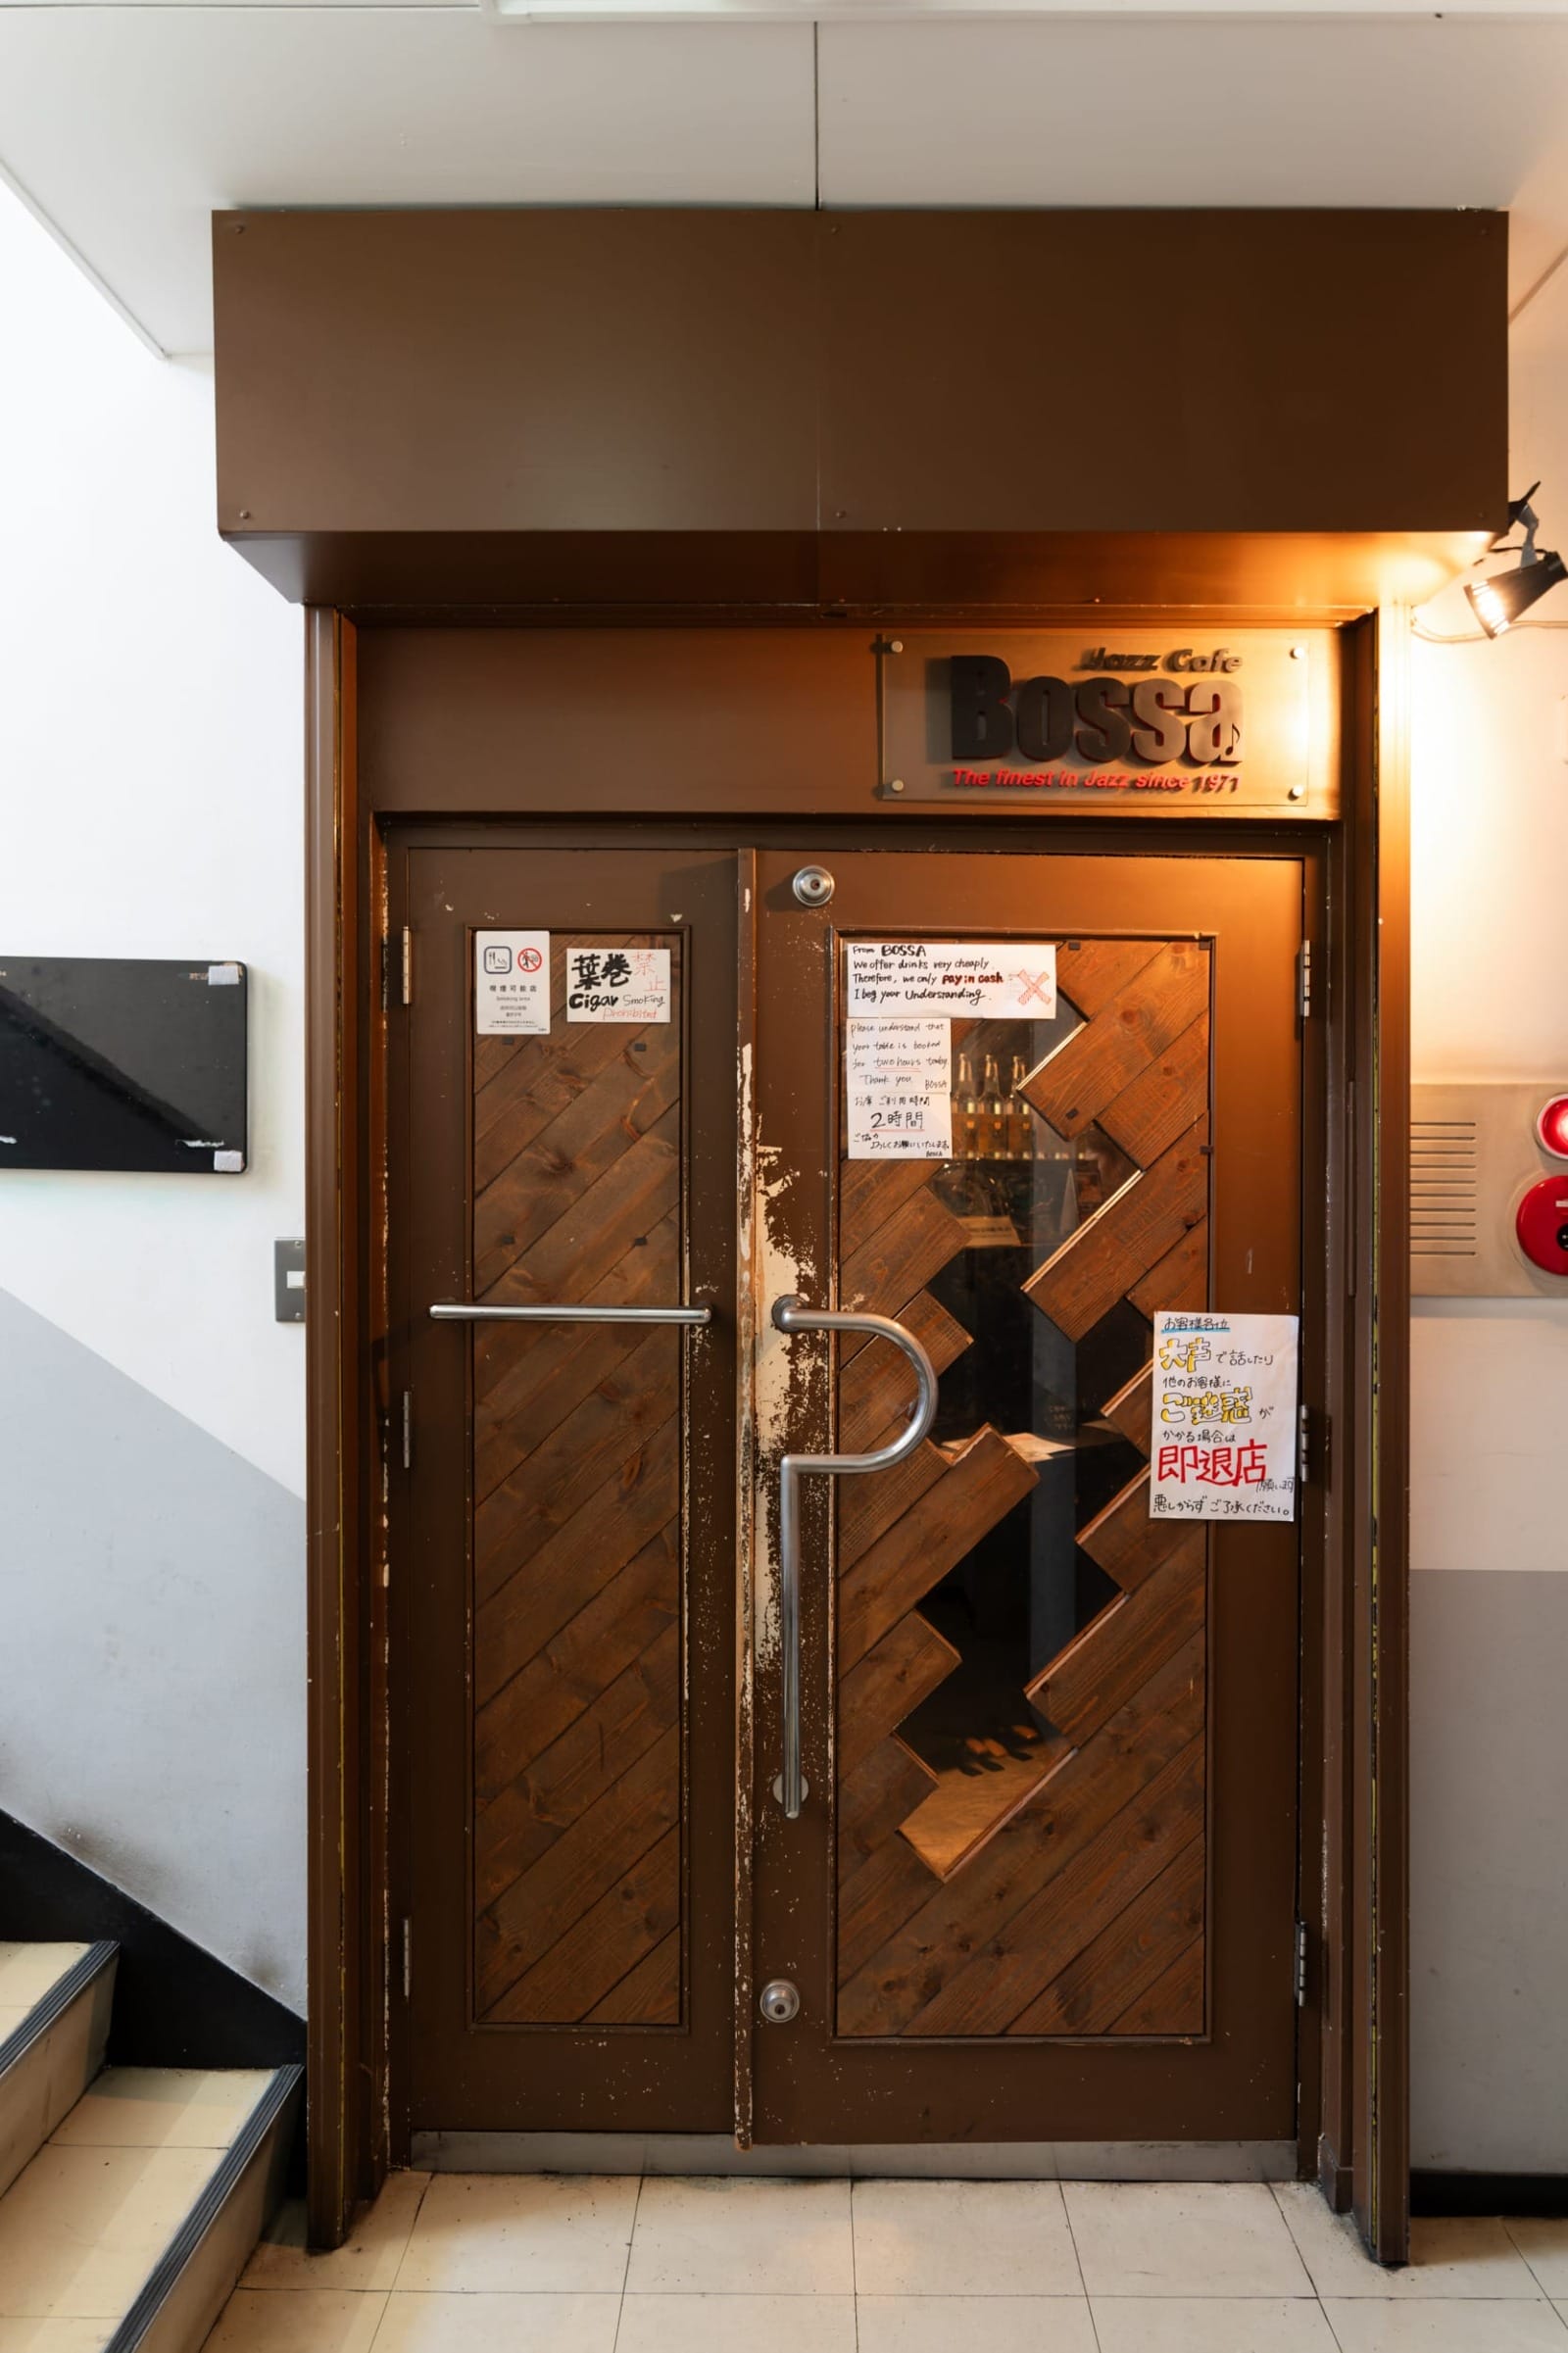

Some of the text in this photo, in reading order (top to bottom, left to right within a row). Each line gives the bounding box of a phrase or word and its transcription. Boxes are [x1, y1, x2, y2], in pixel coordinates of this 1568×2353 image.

[1081, 648, 1244, 672] Jazz Cafe
[951, 655, 1243, 762] Bossa
[954, 769, 1241, 793] The finest in Jazz since 1971
[853, 945, 927, 956] From BOSSA
[571, 953, 632, 991] 葉巻
[854, 960, 868, 969] We
[869, 959, 896, 970] offer
[898, 959, 928, 969] drinks
[933, 961, 952, 971] very
[916, 972, 938, 985] only
[942, 975, 962, 986] pay
[963, 975, 975, 984] in
[978, 971, 1004, 984] cash
[622, 994, 666, 1008] Smoking
[855, 988, 859, 1000] I
[861, 988, 877, 1004] beg
[880, 990, 901, 1005] your
[878, 1022, 921, 1033] understand
[853, 1044, 870, 1054] your
[859, 1074, 890, 1086] Thank
[870, 1110, 923, 1129] 2時間
[1164, 1316, 1231, 1331] お客様各位
[1162, 1375, 1231, 1389] 他のお客様に
[1162, 1429, 1236, 1444] かかる場合は
[1157, 1439, 1268, 1488] 即退店
